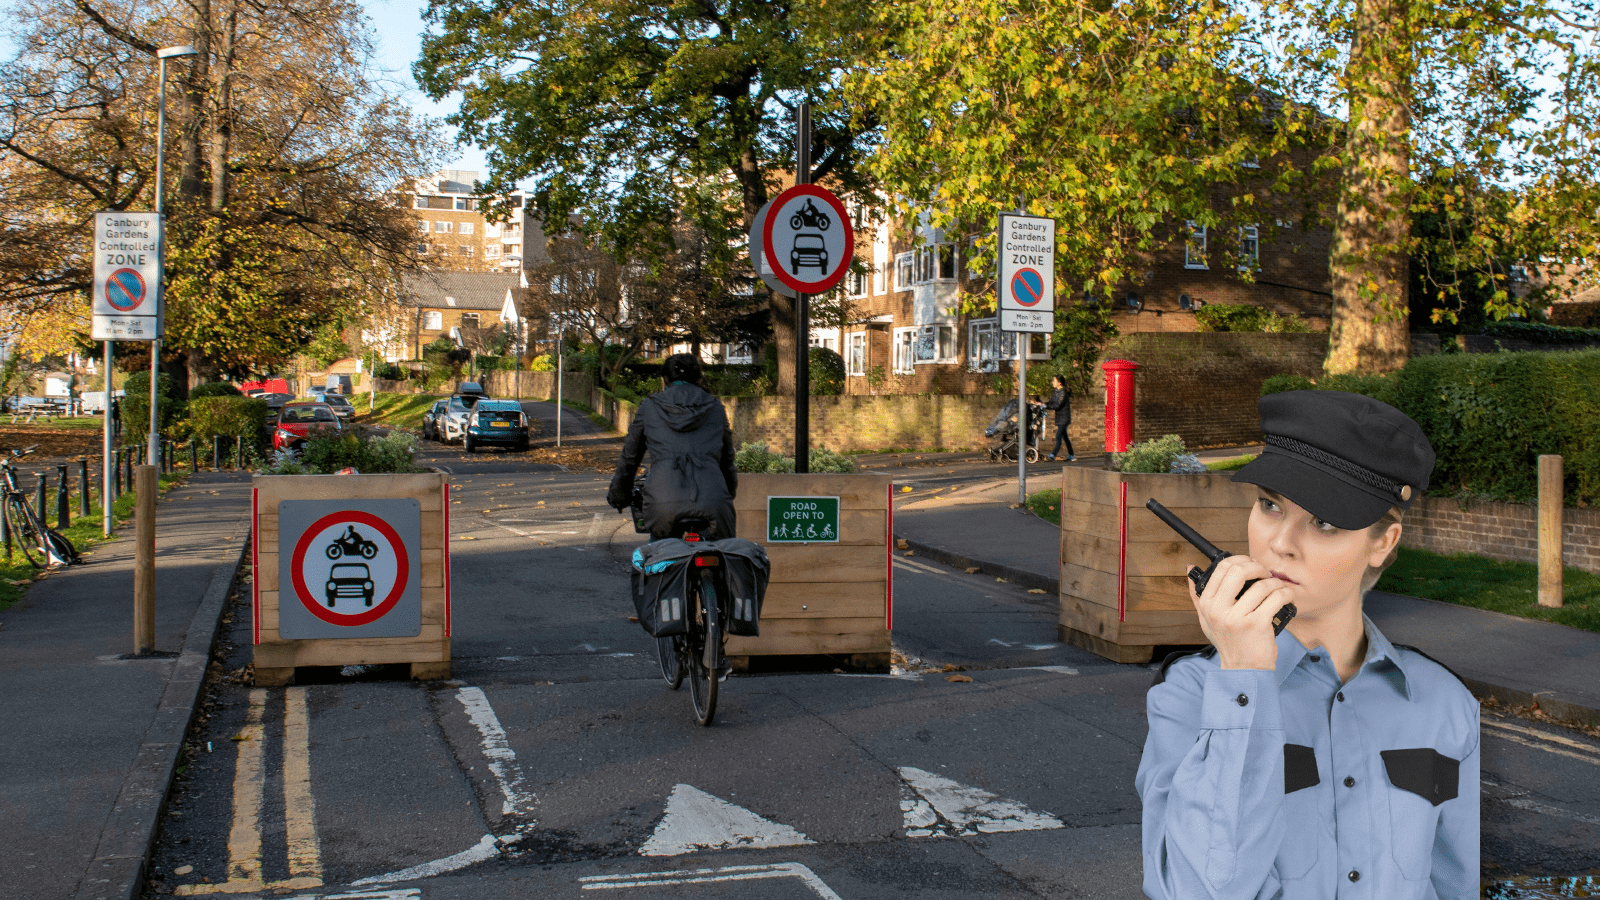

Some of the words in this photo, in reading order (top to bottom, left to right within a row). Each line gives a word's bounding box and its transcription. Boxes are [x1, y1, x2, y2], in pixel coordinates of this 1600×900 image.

[105, 217, 150, 229] Canbury
[1011, 221, 1047, 232] Canbury
[106, 229, 149, 239] Gardens
[1011, 232, 1046, 242] Gardens
[99, 241, 156, 251] Controlled
[1006, 242, 1052, 254] Controlled
[106, 254, 146, 265] ZONE
[1012, 254, 1044, 266] ZONE
[130, 319, 142, 327] Sat
[790, 502, 817, 510] ROAD
[783, 511, 809, 520] OPEN
[812, 511, 825, 520] TO
